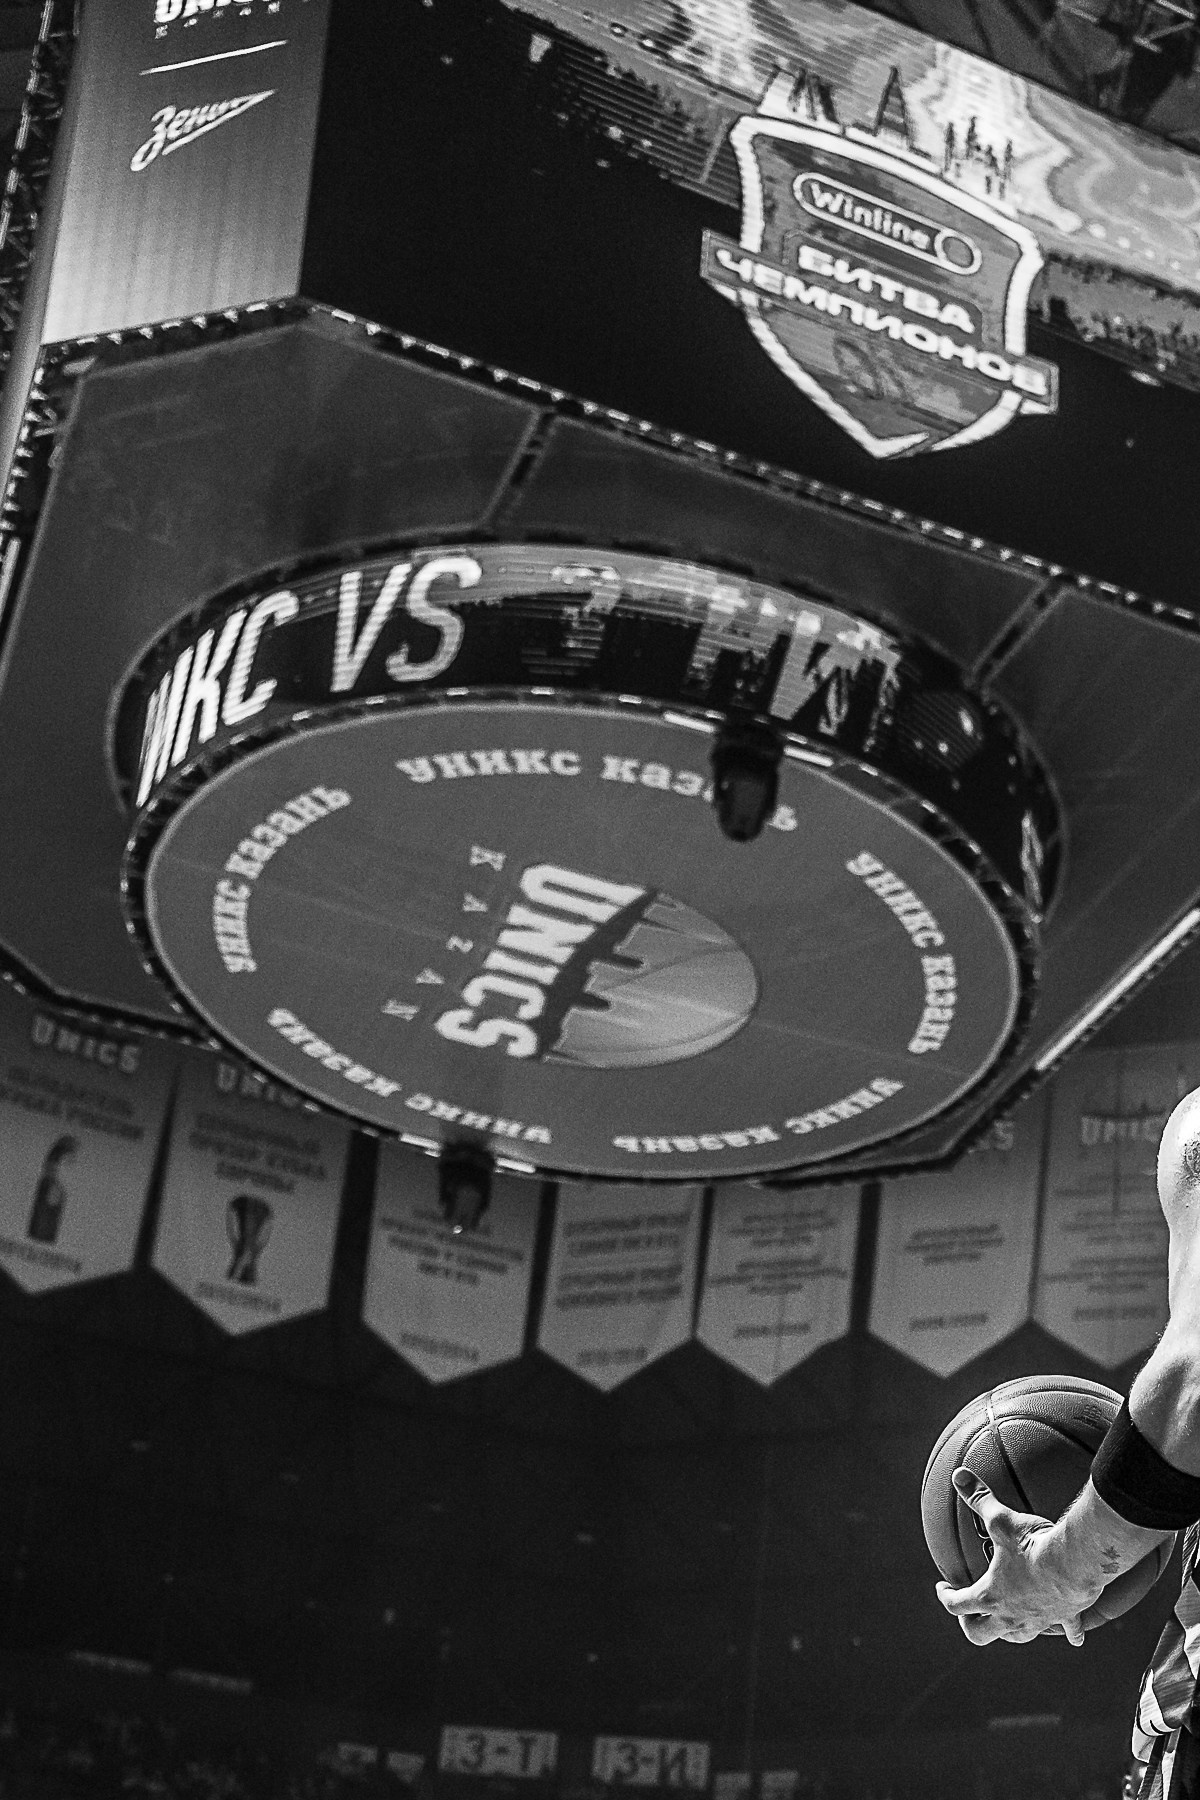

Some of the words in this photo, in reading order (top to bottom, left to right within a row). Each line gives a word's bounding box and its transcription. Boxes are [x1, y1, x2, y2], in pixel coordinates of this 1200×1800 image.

[810, 182, 931, 251] Winline
[716, 248, 1048, 397] ЧЕМПИОНОВ
[798, 244, 976, 334] БИТВА
[330, 556, 483, 692] VS
[433, 863, 648, 1059] UNICS
